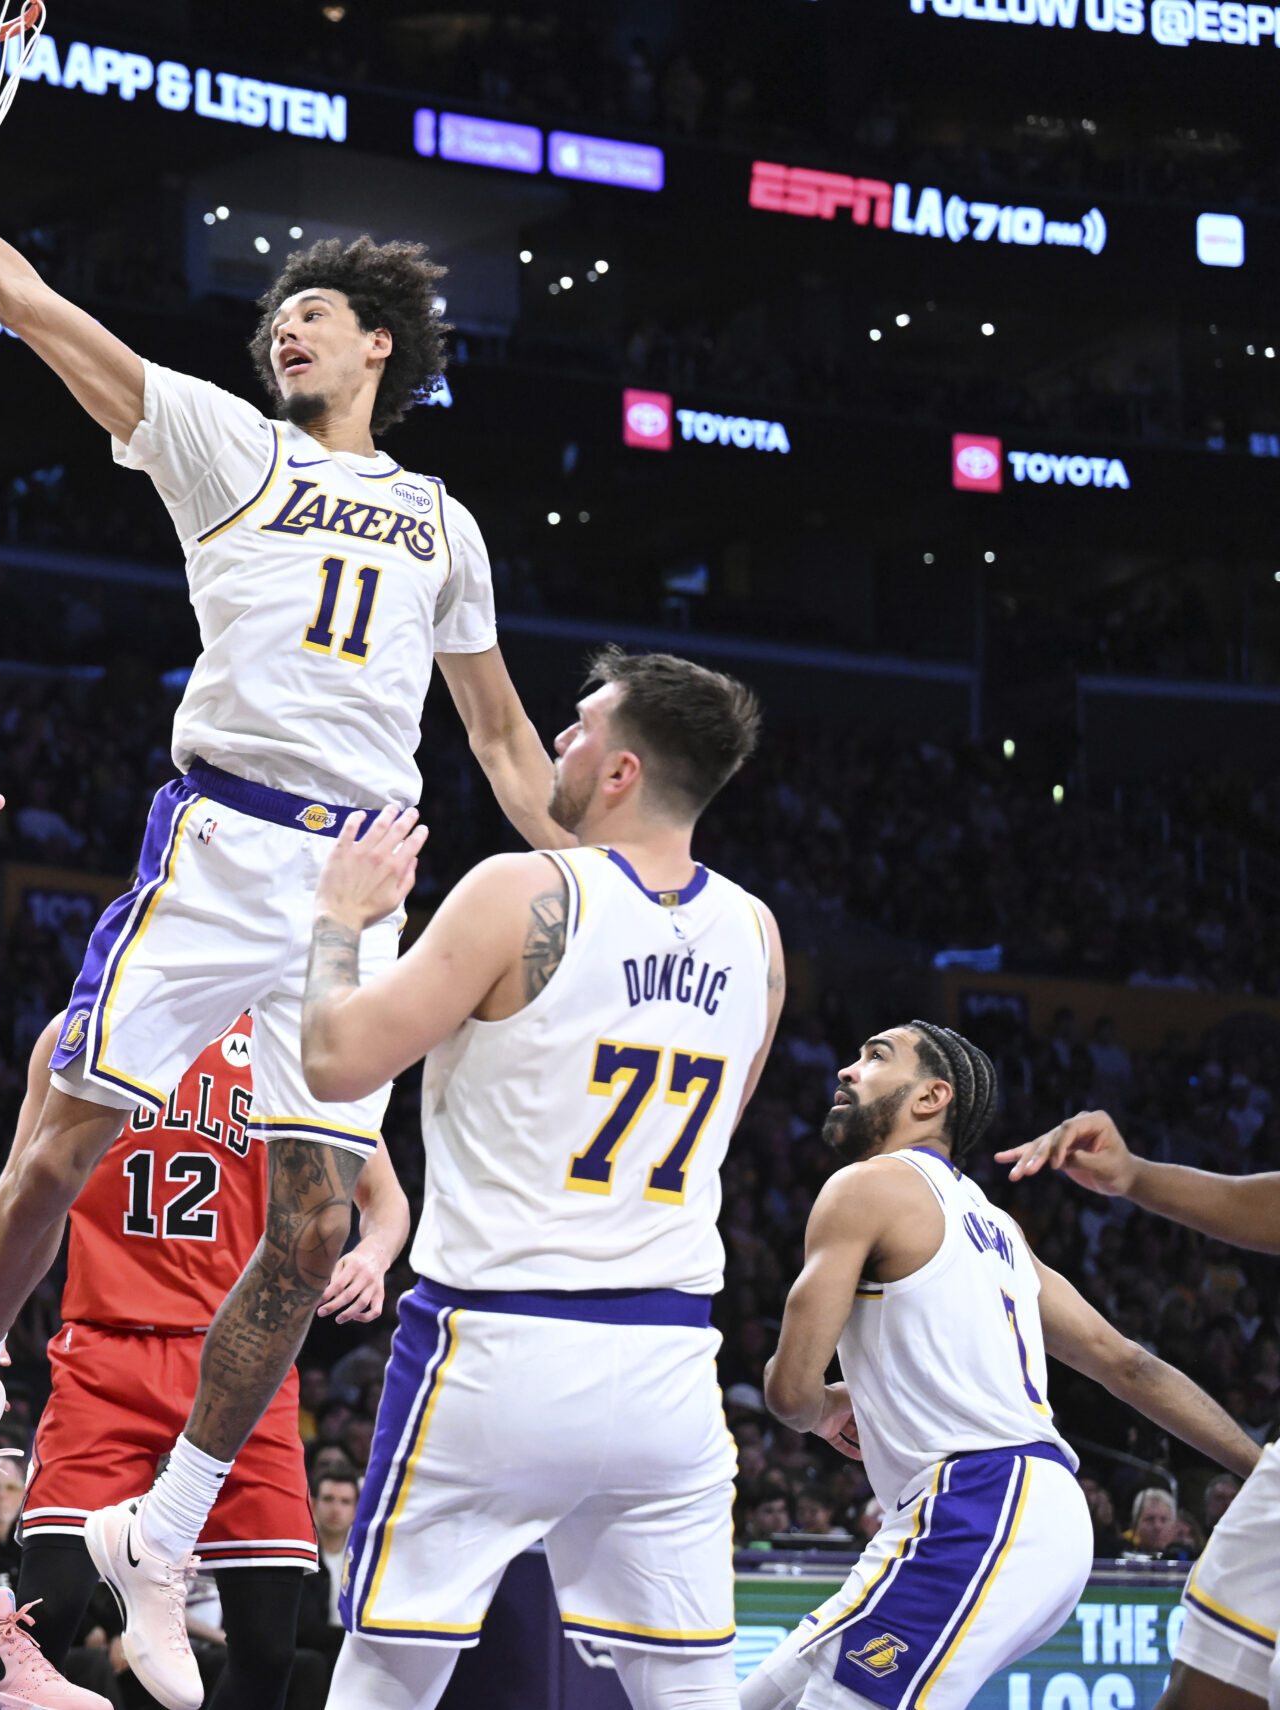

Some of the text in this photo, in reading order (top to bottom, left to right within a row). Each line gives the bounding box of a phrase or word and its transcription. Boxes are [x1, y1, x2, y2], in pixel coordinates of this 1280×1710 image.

[1084, 0, 1145, 35] US
[1150, 0, 1280, 48] @ESP
[62, 41, 154, 101] APP
[155, 60, 193, 111] &
[195, 67, 347, 142] LISTEN
[676, 408, 791, 454] TOYOTA
[395, 487, 431, 507] bibigo
[1007, 450, 1131, 490] TOYOTA
[258, 478, 437, 562] LAKERS
[301, 554, 383, 666] 11
[622, 947, 732, 1017] DONČIĆ
[564, 1038, 728, 1206] 77
[123, 1149, 220, 1241] 12
[1076, 1603, 1160, 1665] THE
